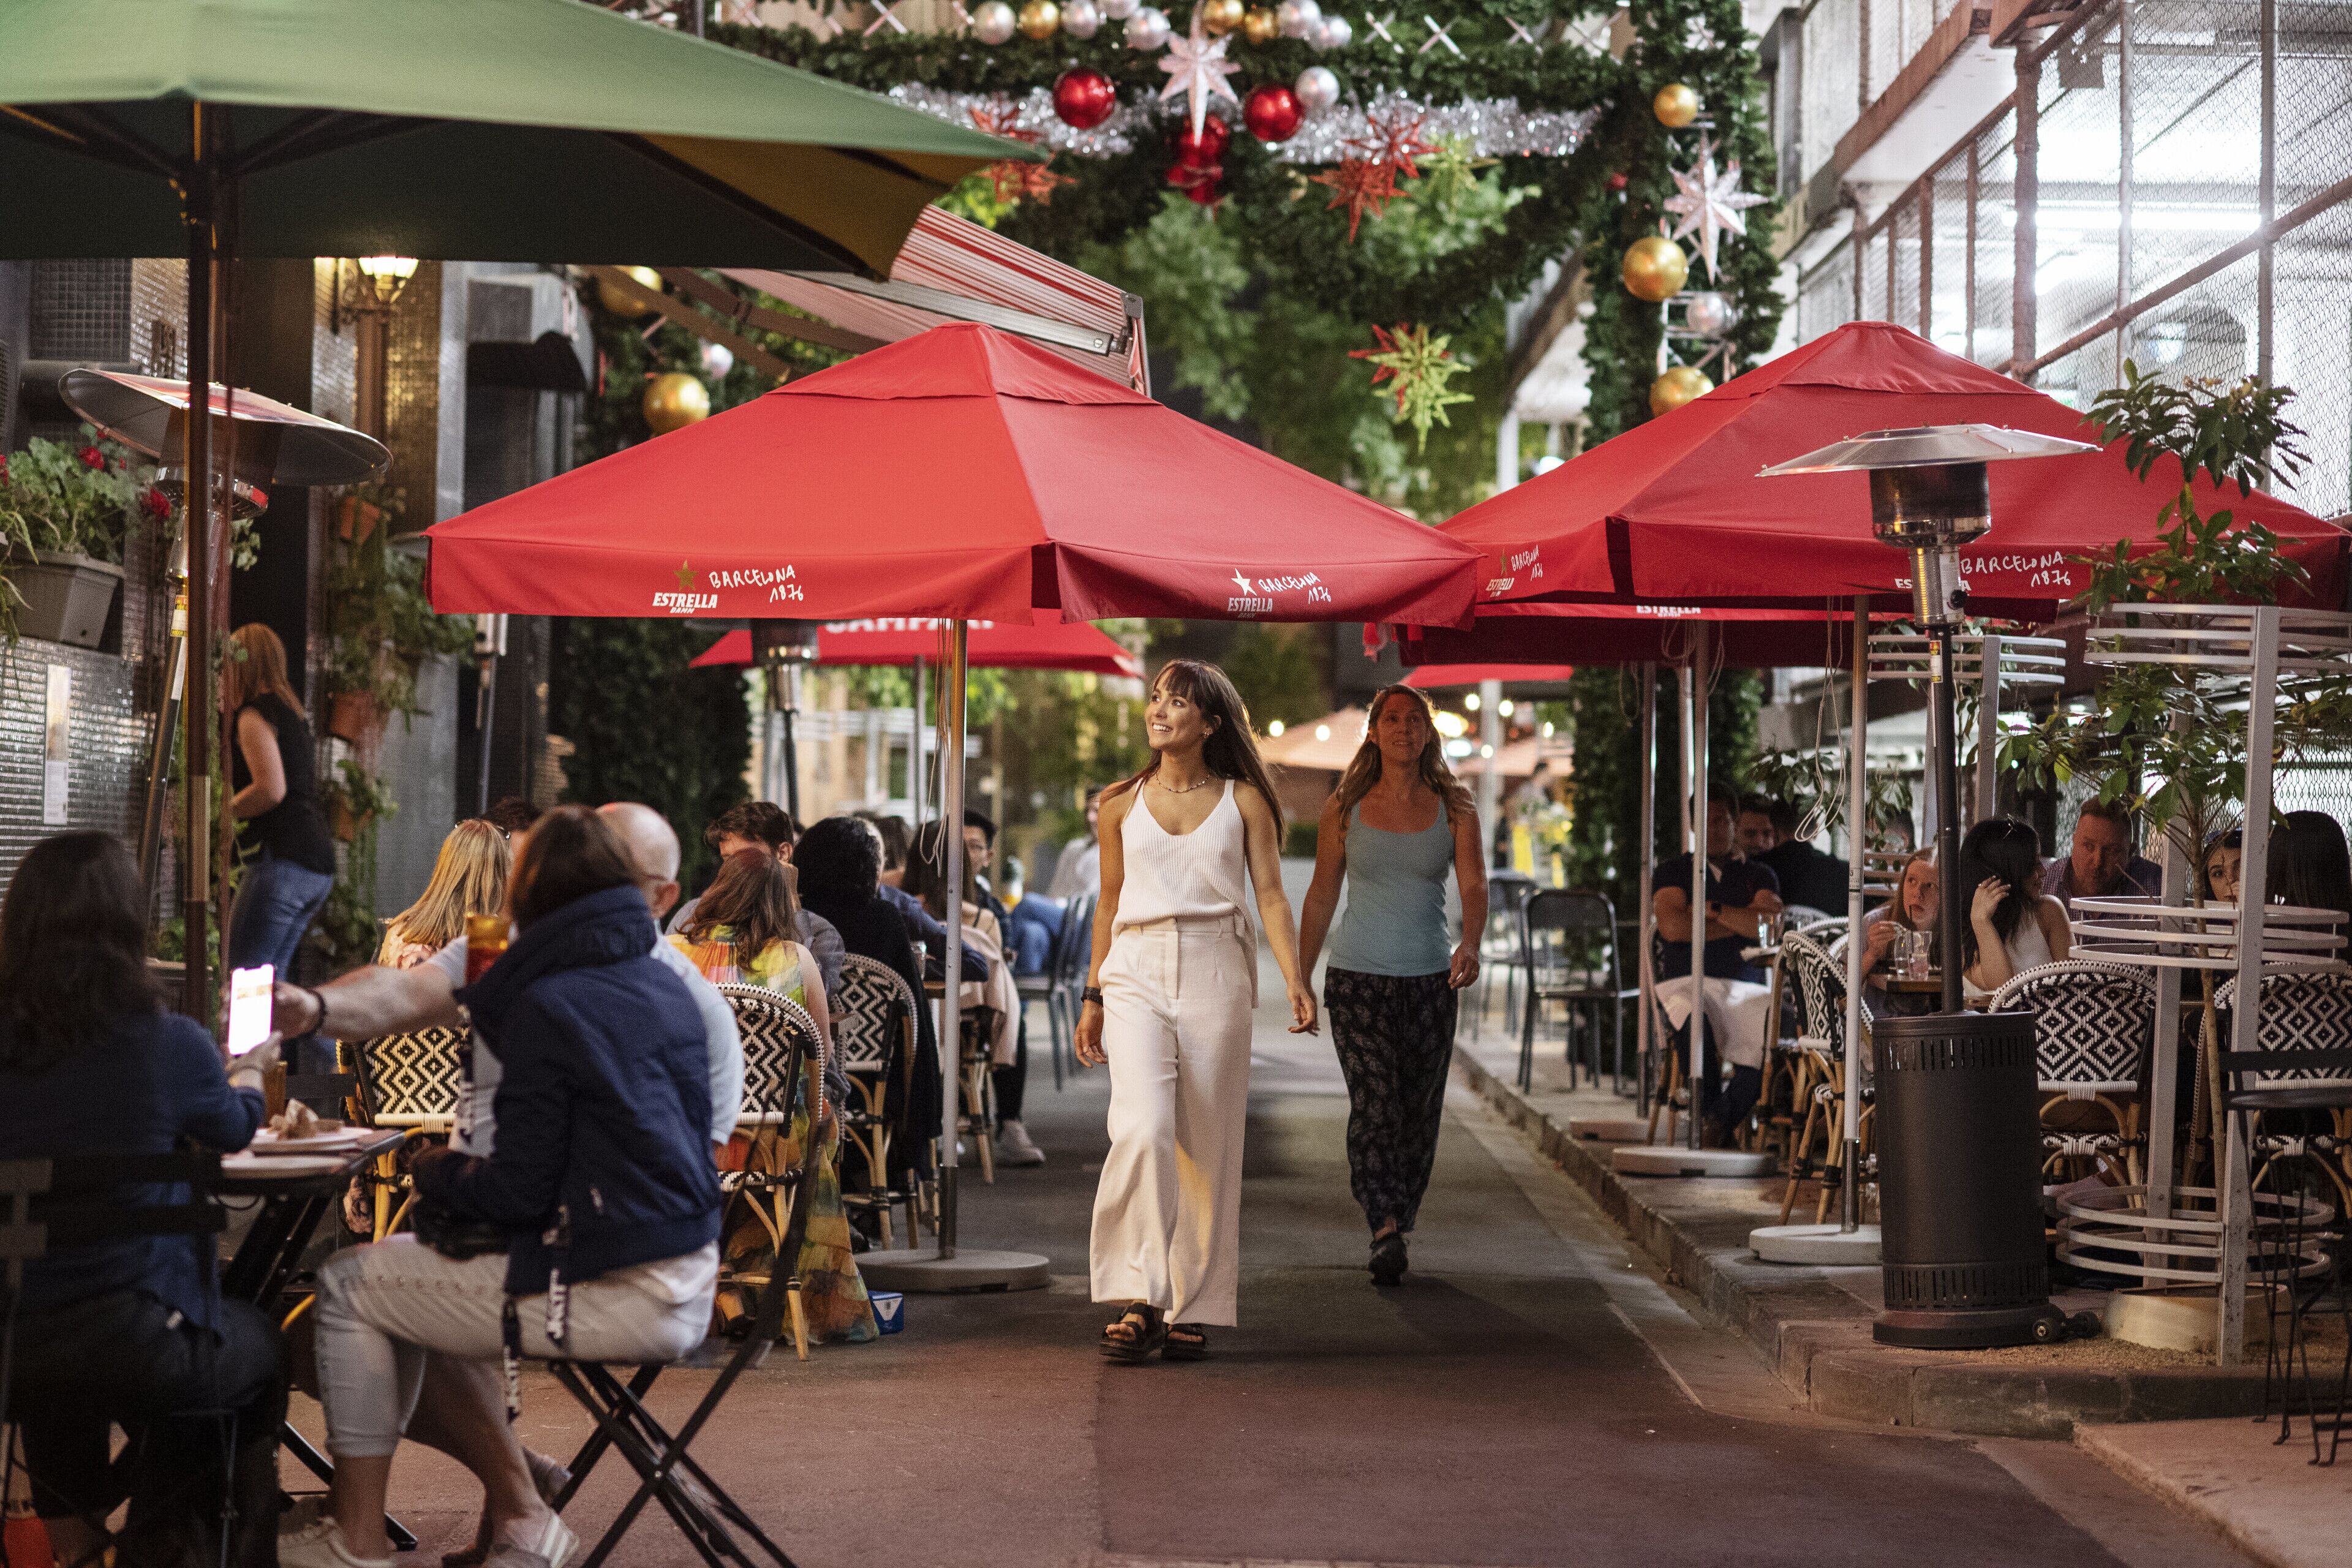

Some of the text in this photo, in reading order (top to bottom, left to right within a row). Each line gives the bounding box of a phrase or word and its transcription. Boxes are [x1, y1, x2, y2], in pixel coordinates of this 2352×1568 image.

[1511, 545, 1539, 571] BARCELONA
[1961, 551, 2064, 574] BARCELONA
[709, 564, 796, 589] BARCELONA
[1258, 571, 1321, 593] BARCELONA
[2031, 570, 2071, 587] 1876
[652, 592, 718, 608] ESTRELLA
[769, 584, 804, 603] 1876
[1308, 586, 1331, 605] 1876
[1227, 597, 1273, 612] ESTRELLA
